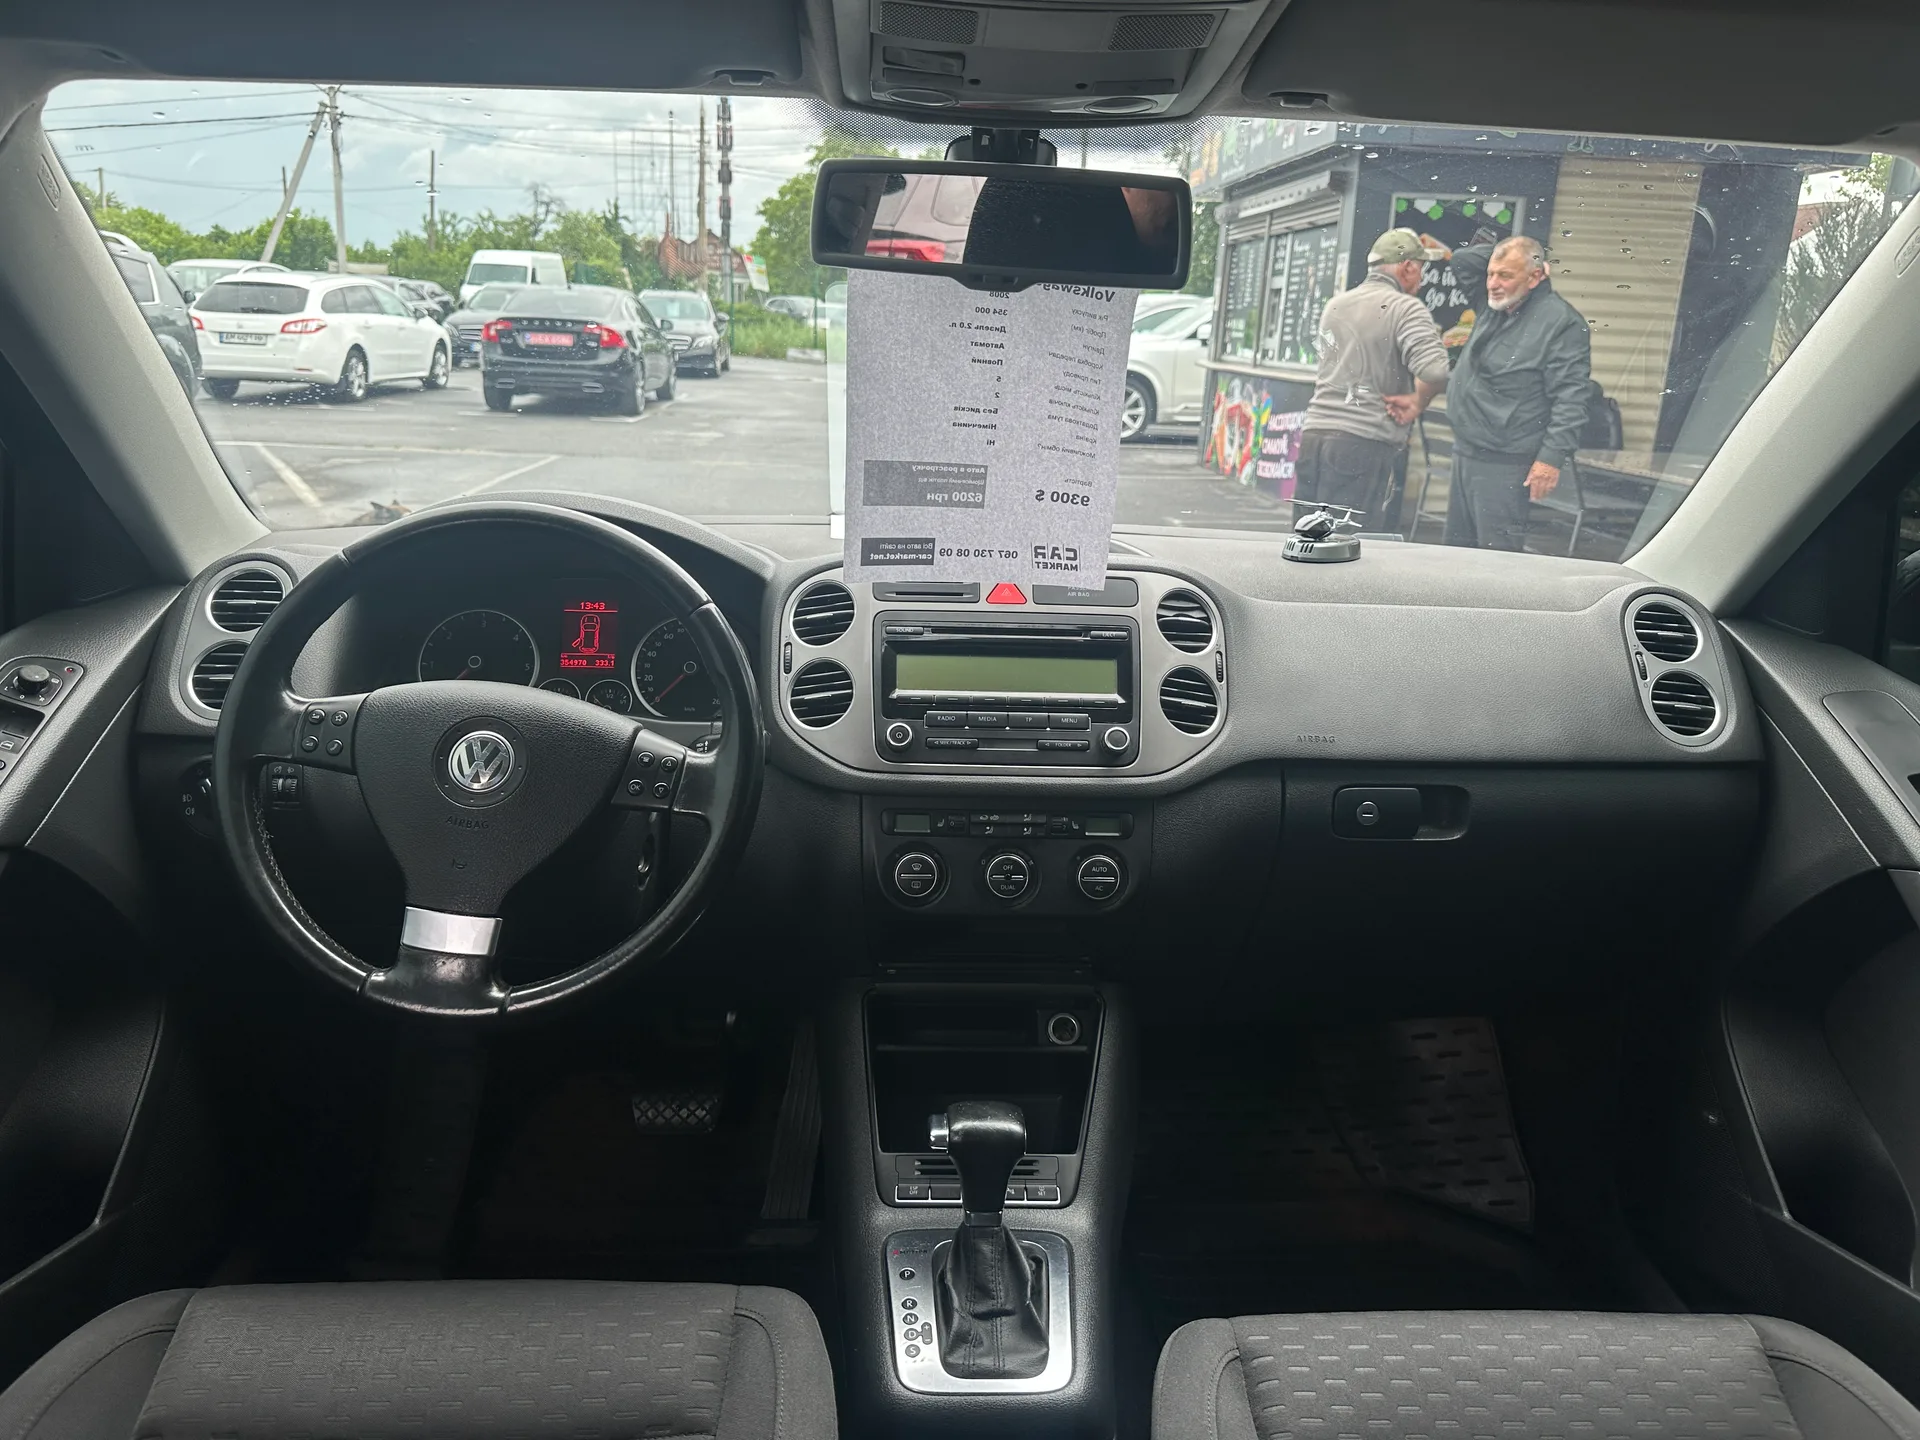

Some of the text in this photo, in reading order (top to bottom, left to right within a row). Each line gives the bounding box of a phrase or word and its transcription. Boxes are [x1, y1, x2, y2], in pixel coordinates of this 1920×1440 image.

[580, 601, 606, 610] 13:43
[481, 620, 487, 628] 3
[524, 663, 530, 671] 5
[643, 674, 653, 682] 20
[1296, 735, 1336, 744] AIRBAG
[446, 816, 489, 829] AIRBAG
[906, 1300, 913, 1308] R
[906, 1315, 915, 1323] N
[909, 1347, 916, 1355] S
